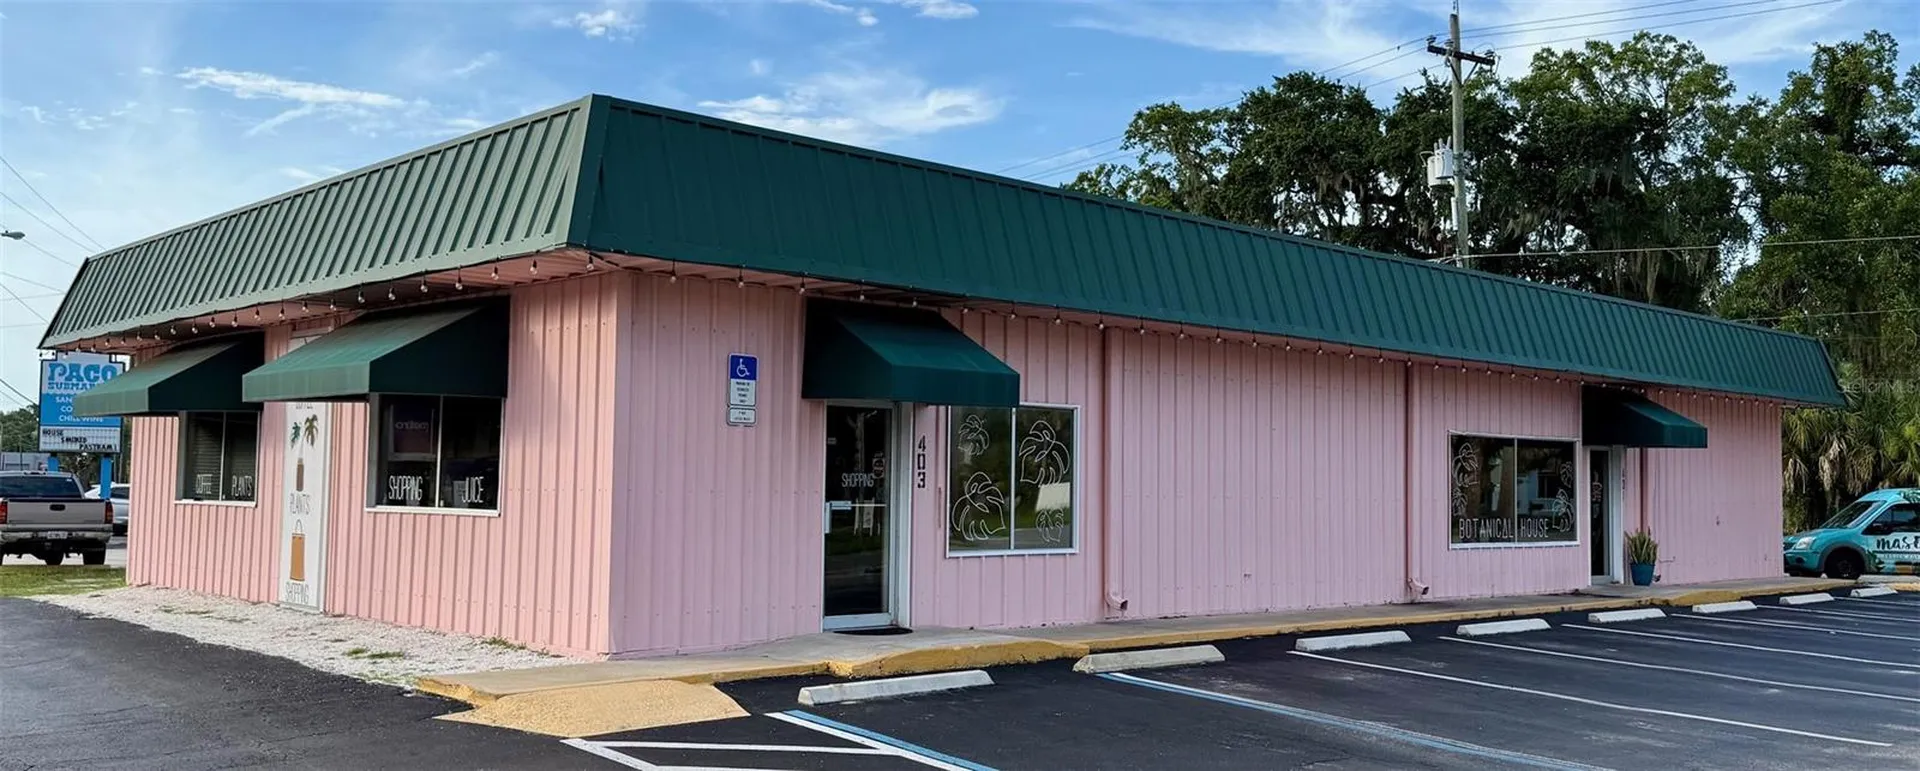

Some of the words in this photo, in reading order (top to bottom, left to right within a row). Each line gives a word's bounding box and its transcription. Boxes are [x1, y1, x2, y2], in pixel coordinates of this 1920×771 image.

[48, 363, 117, 383] PACO
[917, 435, 927, 488] 403
[388, 475, 424, 501] SHOPPING
[461, 476, 485, 503] JUICE
[841, 473, 875, 488] SHOPPING
[1459, 518, 1514, 540] BOTANICAL
[1520, 517, 1550, 539] HOUSE
